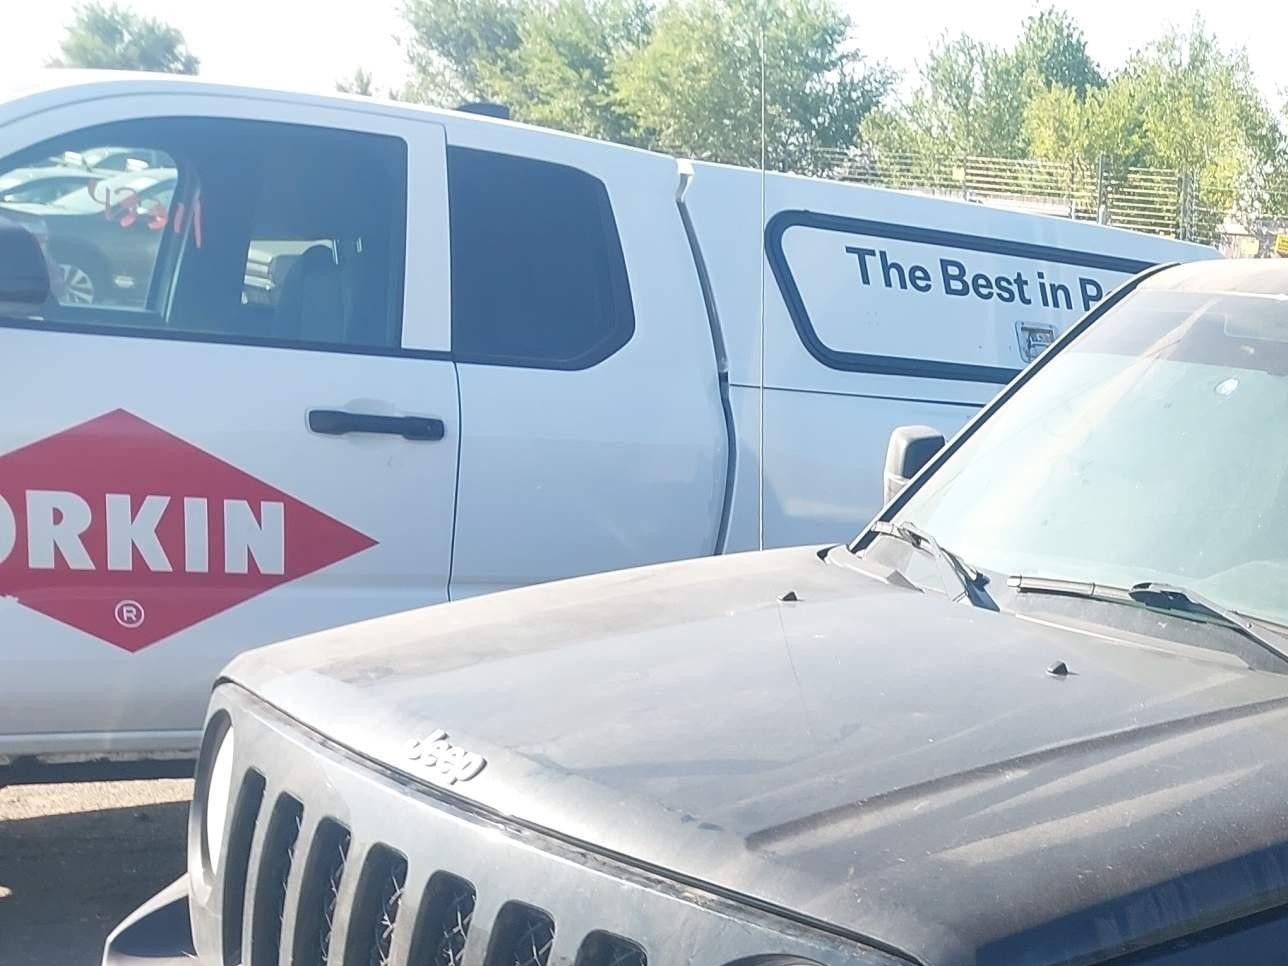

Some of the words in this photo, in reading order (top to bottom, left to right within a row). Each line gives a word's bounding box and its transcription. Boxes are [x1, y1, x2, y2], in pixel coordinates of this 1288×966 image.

[845, 246, 932, 292] The
[939, 258, 1032, 305] Best
[1037, 272, 1074, 310] in
[0, 489, 285, 575] RKIN
[404, 727, 488, 786] Jeep
